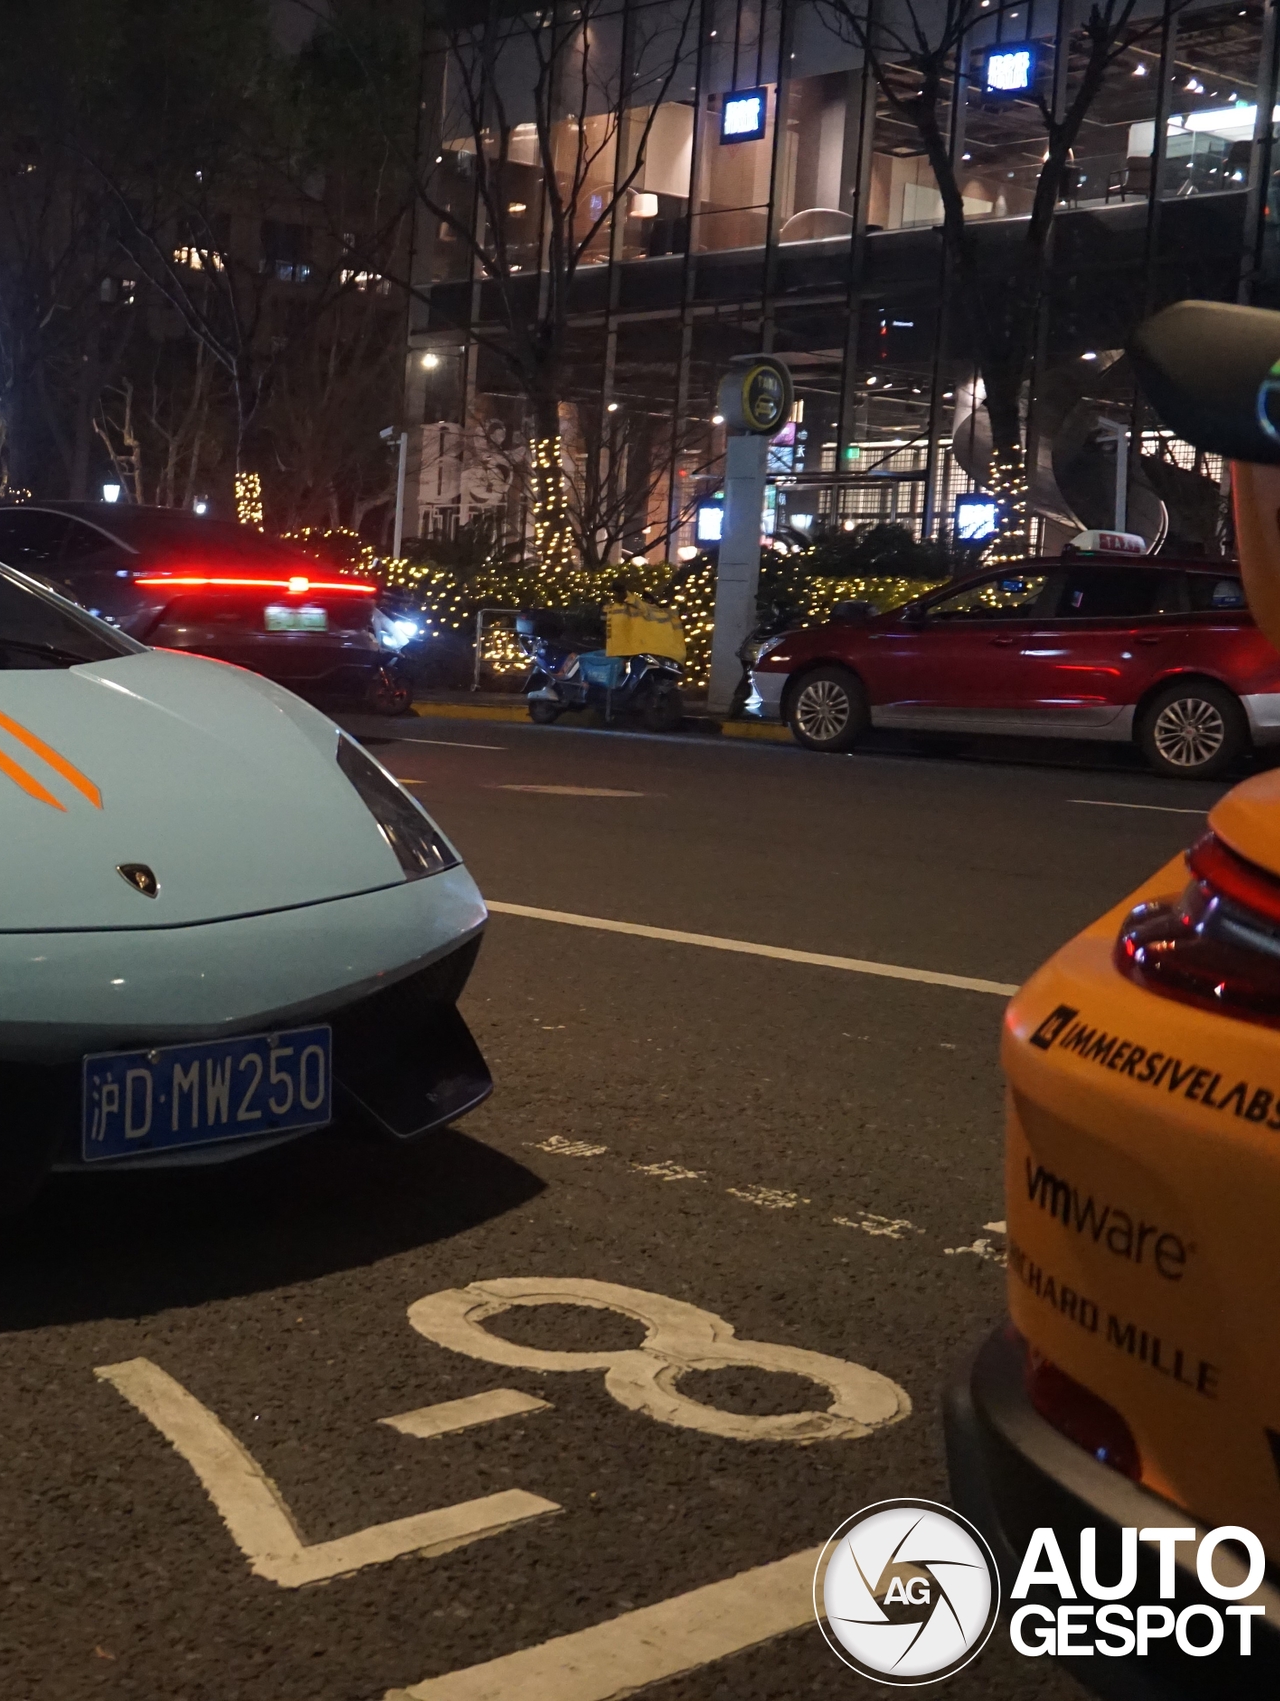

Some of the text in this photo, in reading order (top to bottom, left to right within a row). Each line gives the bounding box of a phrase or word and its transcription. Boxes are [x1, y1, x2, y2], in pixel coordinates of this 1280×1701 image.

[1025, 1156, 1187, 1283] vmware
[1010, 1240, 1221, 1400] CHARD MILLE
